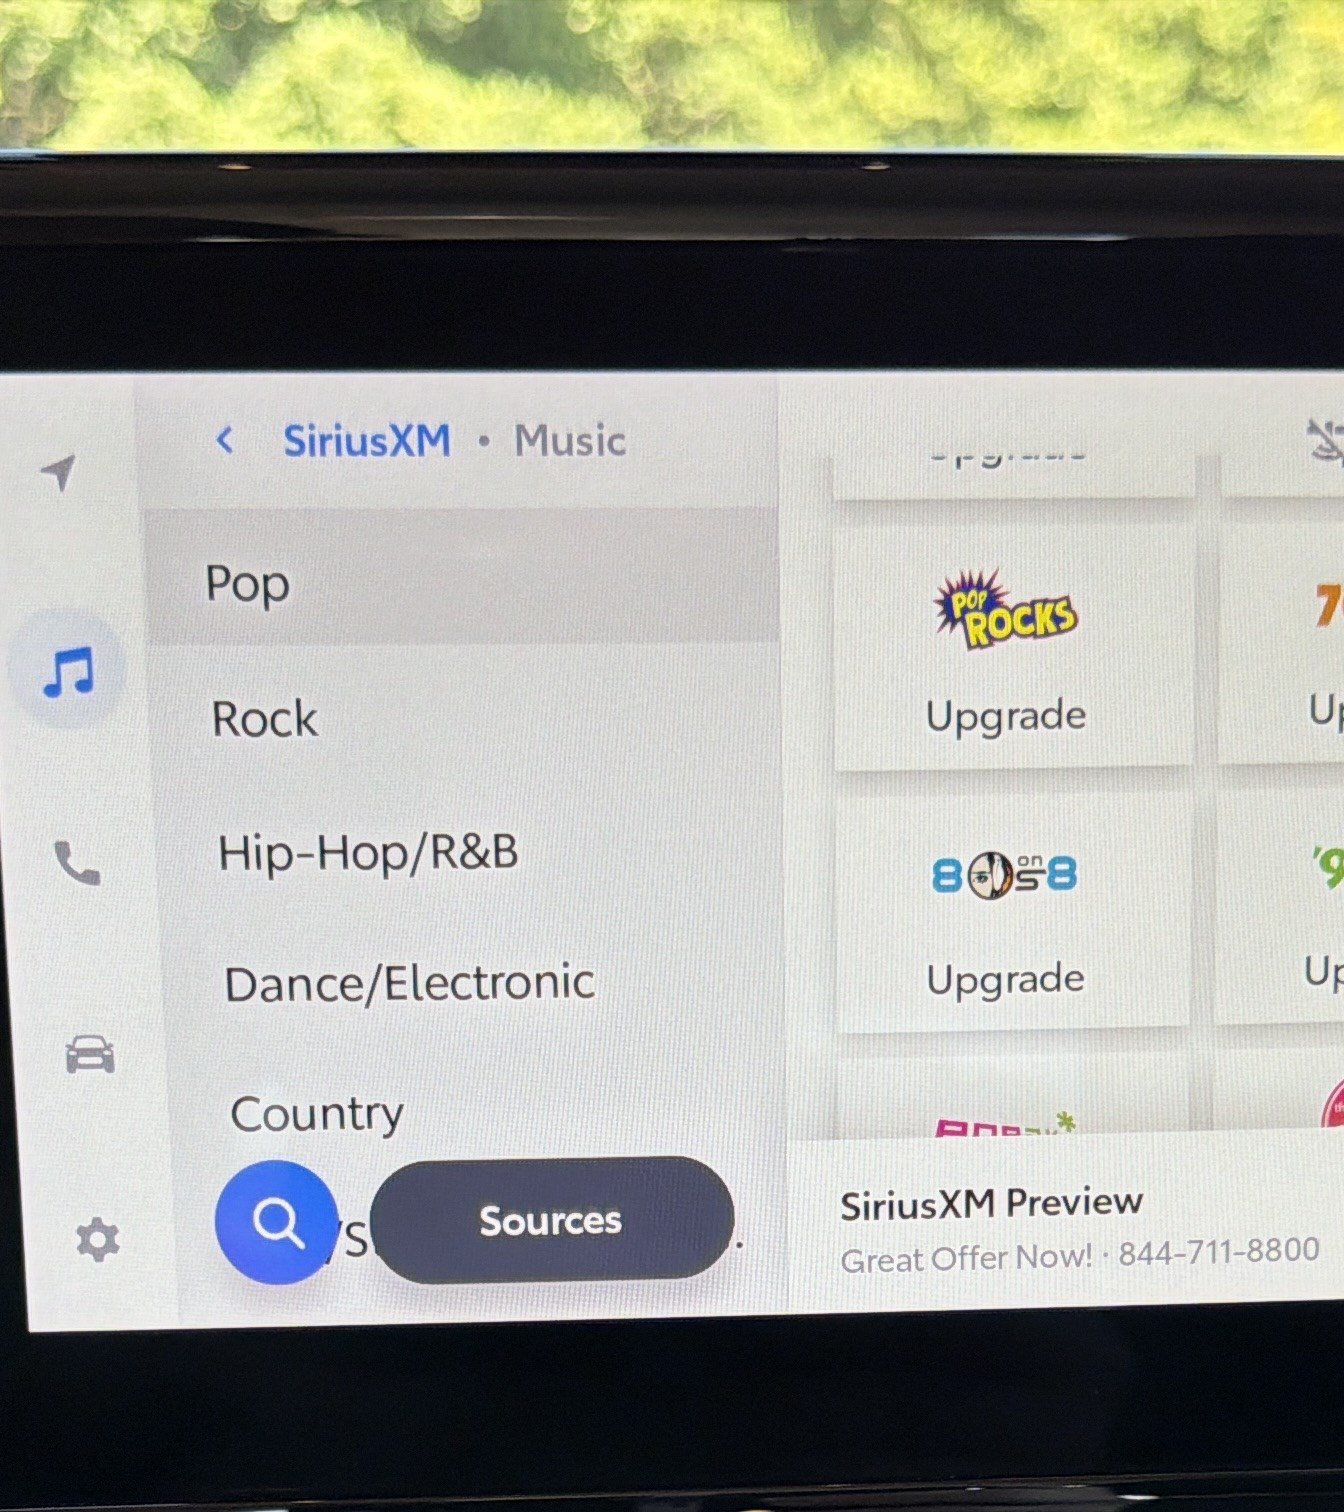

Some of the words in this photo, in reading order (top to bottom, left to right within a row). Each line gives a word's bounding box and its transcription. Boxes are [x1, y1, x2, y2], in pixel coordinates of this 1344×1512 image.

[284, 423, 451, 458] SiriusXM
[515, 422, 627, 457] Music
[206, 564, 290, 611] Pop
[952, 589, 988, 618] POP
[965, 599, 1076, 647] ROCKS
[212, 697, 319, 738] Rock
[925, 698, 1087, 739] Upgrade
[219, 830, 519, 880] Hip-Hop/R&B
[225, 961, 596, 1008] Dance/Electronic
[926, 962, 1085, 1003] Upgrade
[231, 1095, 404, 1139] Country
[480, 1204, 622, 1237] Sources
[840, 1189, 995, 1223] SiriusXM
[1007, 1187, 1144, 1219] Preview
[840, 1246, 924, 1275] Great
[931, 1242, 1009, 1272] Offer
[1016, 1240, 1092, 1270] Now!
[1118, 1235, 1321, 1267] 844-711-8800
